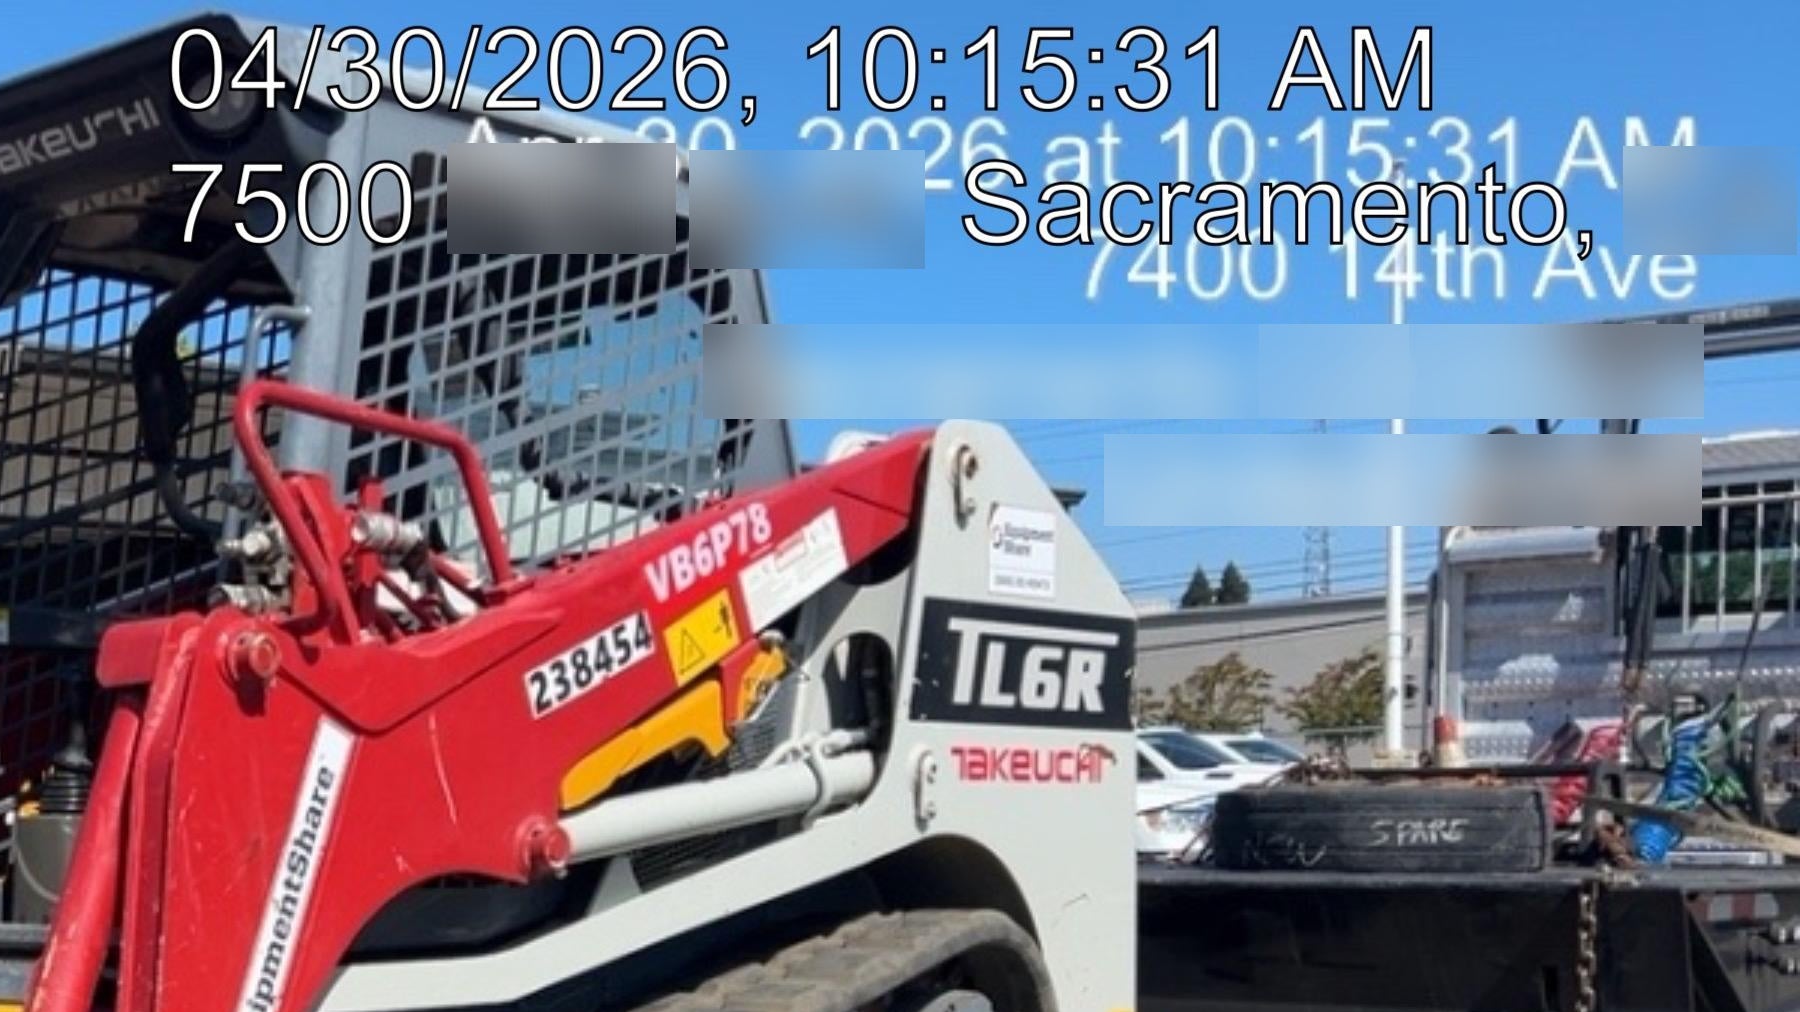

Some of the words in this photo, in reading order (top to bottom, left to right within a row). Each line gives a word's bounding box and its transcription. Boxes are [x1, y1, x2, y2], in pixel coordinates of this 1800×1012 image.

[643, 502, 772, 603] VB6P78
[528, 610, 655, 714] 238454
[947, 616, 1119, 713] TL6R
[1368, 817, 1470, 847] SPARE
